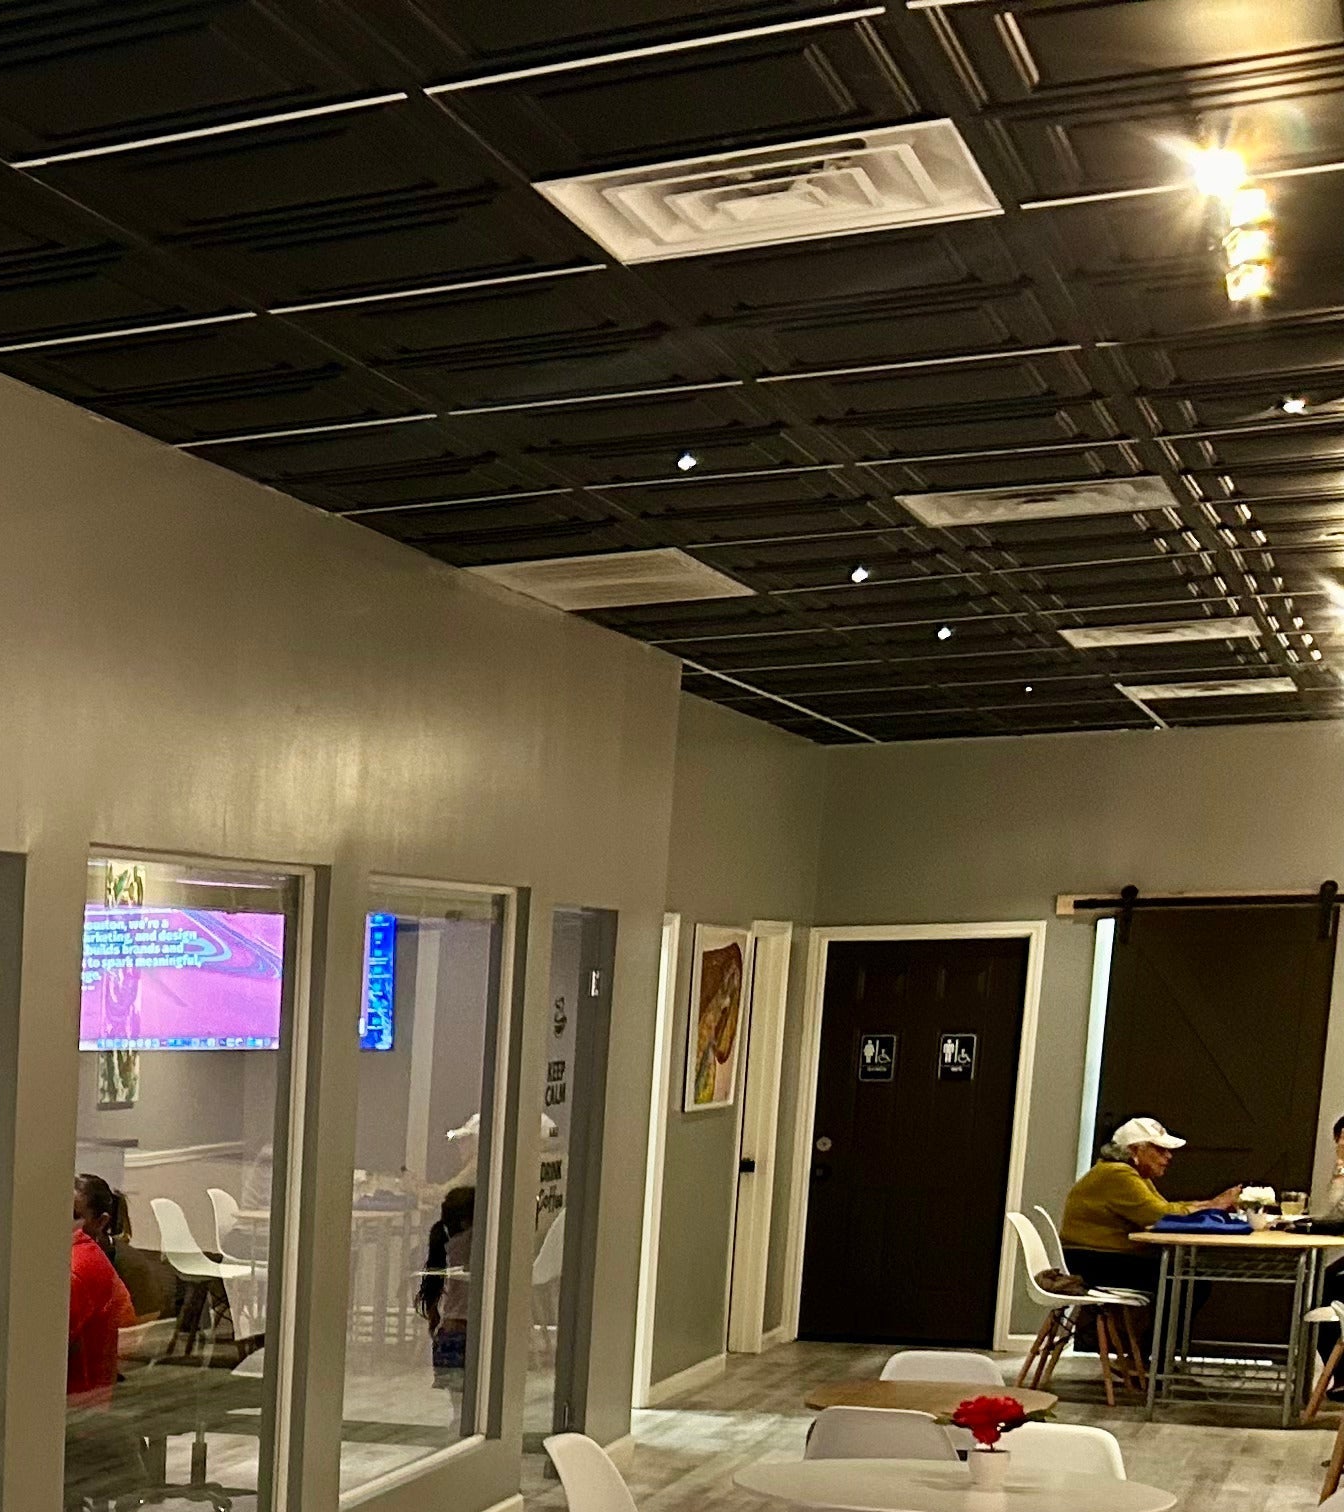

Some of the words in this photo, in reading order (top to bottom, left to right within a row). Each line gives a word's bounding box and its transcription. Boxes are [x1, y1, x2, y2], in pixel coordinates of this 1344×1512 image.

[129, 917, 159, 929] we're
[161, 920, 169, 929] a
[135, 930, 157, 941] and
[158, 928, 198, 944] design
[122, 943, 161, 954] brands
[162, 942, 184, 953] and
[87, 957, 101, 968] to
[101, 956, 133, 971] spark
[546, 1060, 566, 1082] KEEP
[545, 1083, 566, 1107] CALM
